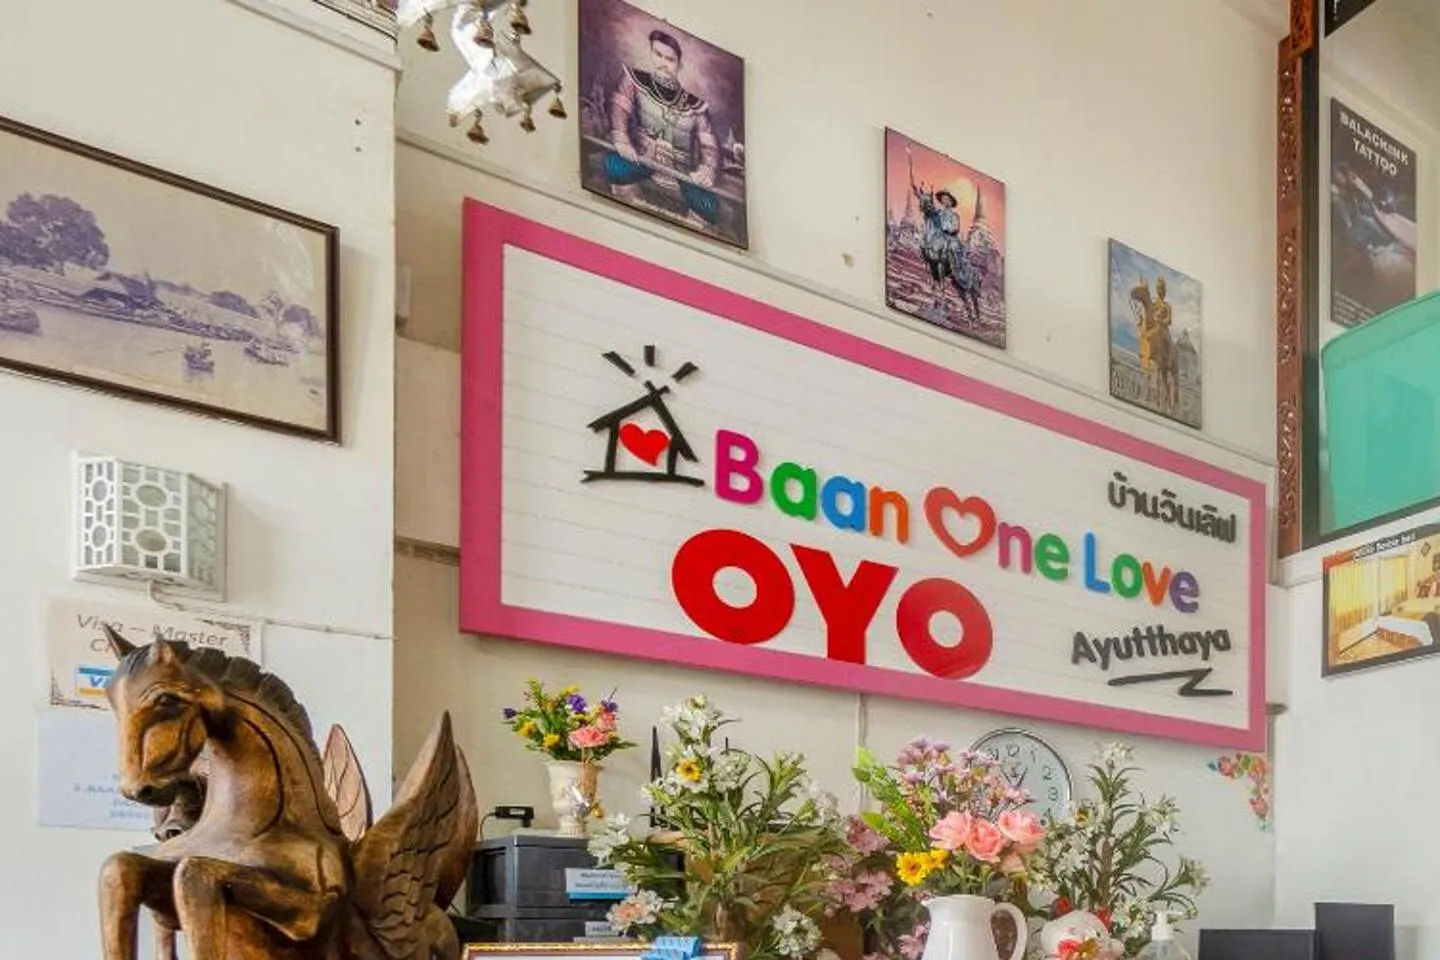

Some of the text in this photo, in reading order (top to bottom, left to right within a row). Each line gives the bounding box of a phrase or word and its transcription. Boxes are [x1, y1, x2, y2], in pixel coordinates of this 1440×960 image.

[1353, 138, 1397, 176] TATTOO
[714, 429, 910, 545] Baan
[1083, 531, 1200, 614] Love
[672, 528, 994, 680] OYO
[151, 623, 229, 645] Master
[1070, 623, 1231, 673] Ayutthaya
